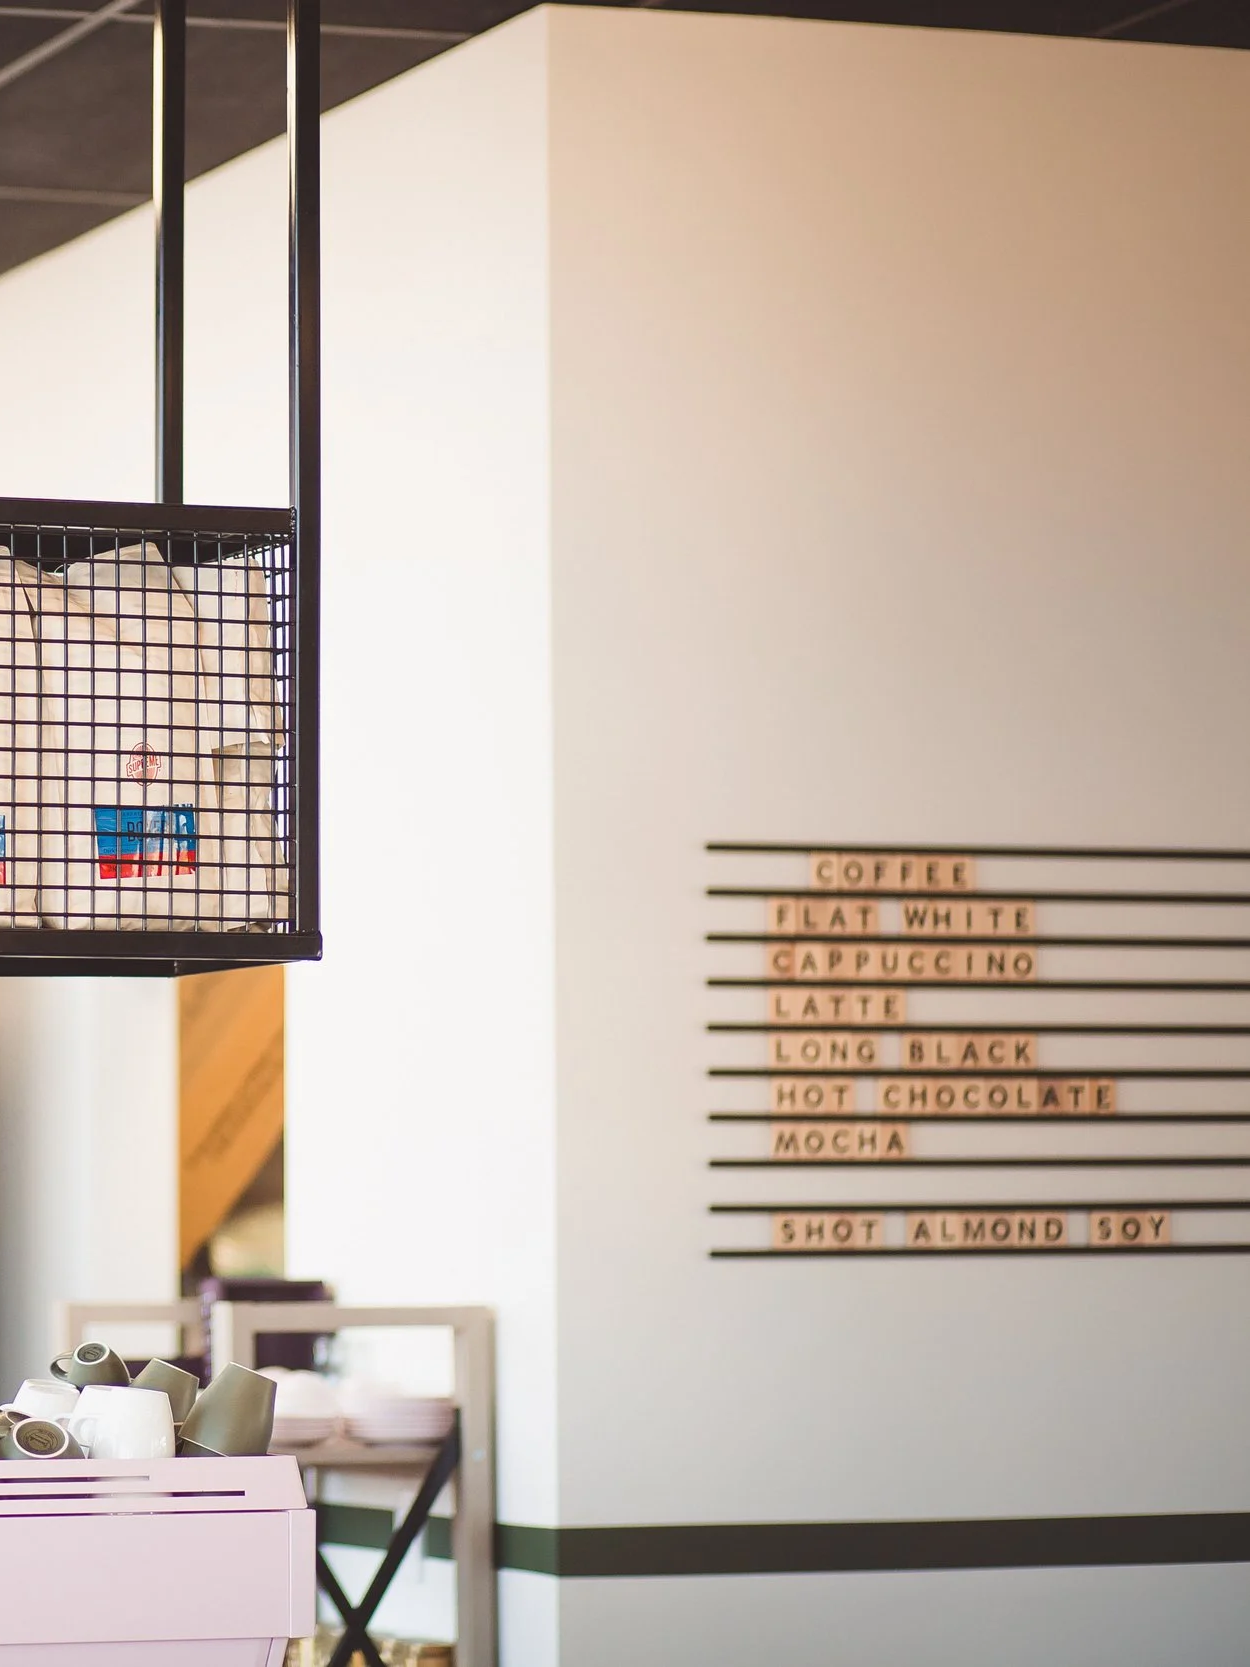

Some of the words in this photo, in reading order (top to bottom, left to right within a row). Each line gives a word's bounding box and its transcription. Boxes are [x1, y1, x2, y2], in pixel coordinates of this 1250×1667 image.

[815, 860, 969, 887] COFFEE
[775, 906, 873, 932] FLAT
[903, 905, 1032, 932] WHITE
[772, 949, 1034, 976] CAPPUCCINO
[774, 994, 899, 1020] LATTE
[775, 1039, 877, 1064] LONG
[908, 1037, 1033, 1065] BLACK
[776, 1084, 850, 1109] HOT
[882, 1083, 1113, 1111] CHOCOLATE
[773, 1127, 906, 1154] MOCHA
[780, 1218, 879, 1244] SHOT
[912, 1216, 1064, 1242] ALMOND
[1096, 1215, 1168, 1241] SOY
